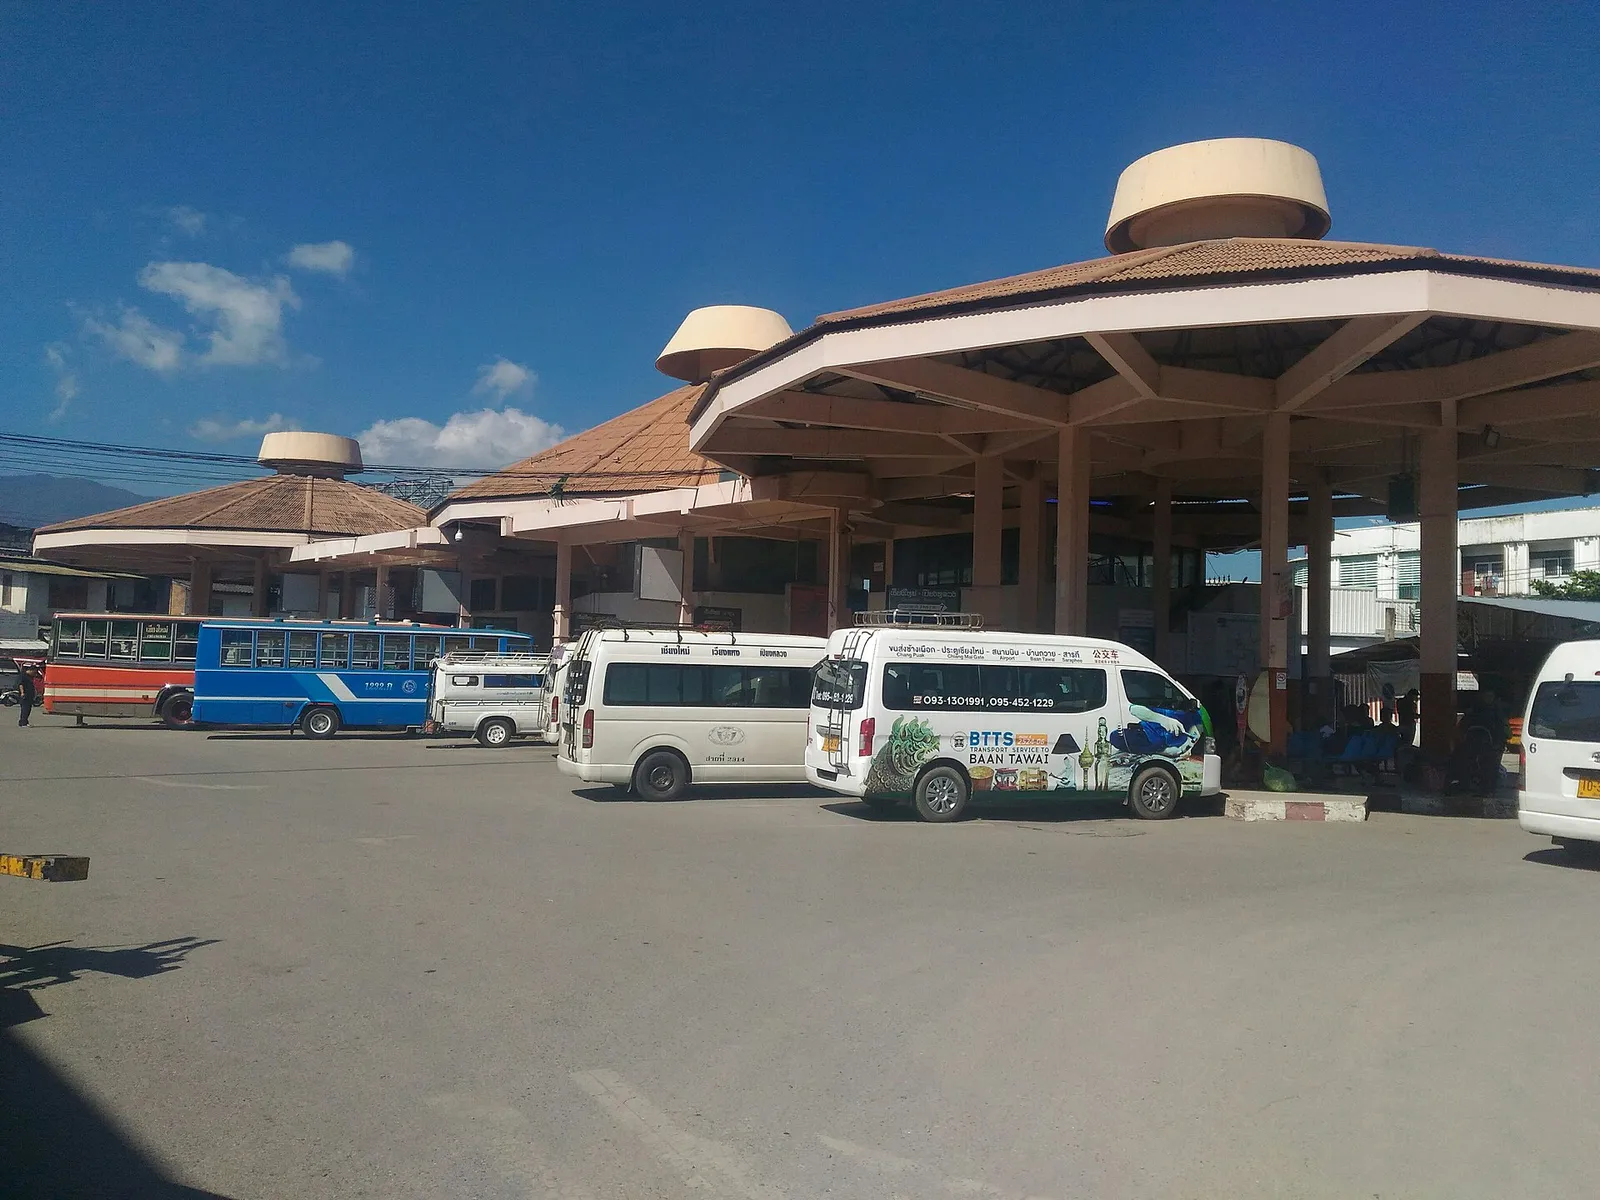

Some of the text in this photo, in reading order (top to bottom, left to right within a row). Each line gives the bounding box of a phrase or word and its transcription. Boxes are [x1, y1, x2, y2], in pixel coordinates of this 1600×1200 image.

[660, 645, 691, 656] เชียงใหม่
[992, 648, 1019, 656] สนามบิน
[1092, 649, 1119, 660] 公交车
[923, 695, 984, 706] 093-1301991
[969, 731, 1014, 747] BTTS
[1529, 742, 1537, 754] 6
[969, 753, 1050, 765] BAAN TAWAI
